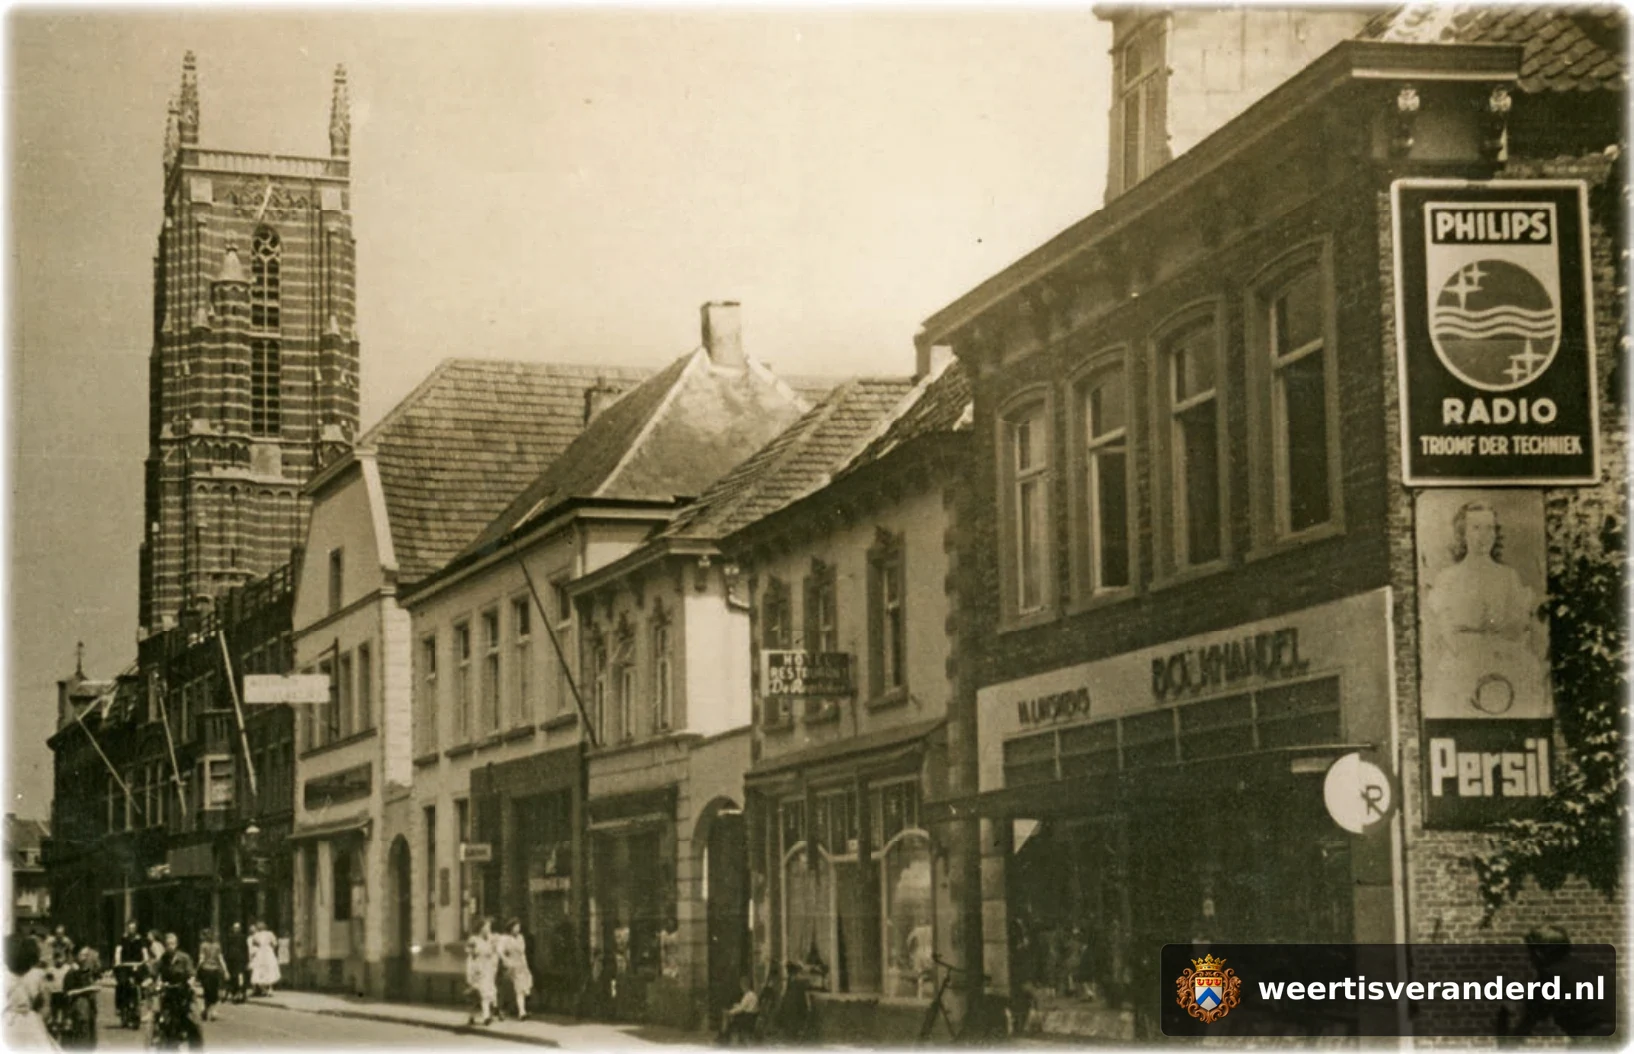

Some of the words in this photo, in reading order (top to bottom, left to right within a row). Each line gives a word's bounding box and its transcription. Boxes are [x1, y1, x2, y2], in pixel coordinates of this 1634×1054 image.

[1435, 211, 1549, 241] PHILIPS
[1442, 398, 1558, 425] RADIO
[1420, 435, 1476, 455] TRIOMF
[1478, 435, 1510, 455] DER
[1512, 435, 1583, 455] TECHNIEK
[1429, 738, 1549, 797] Persil
